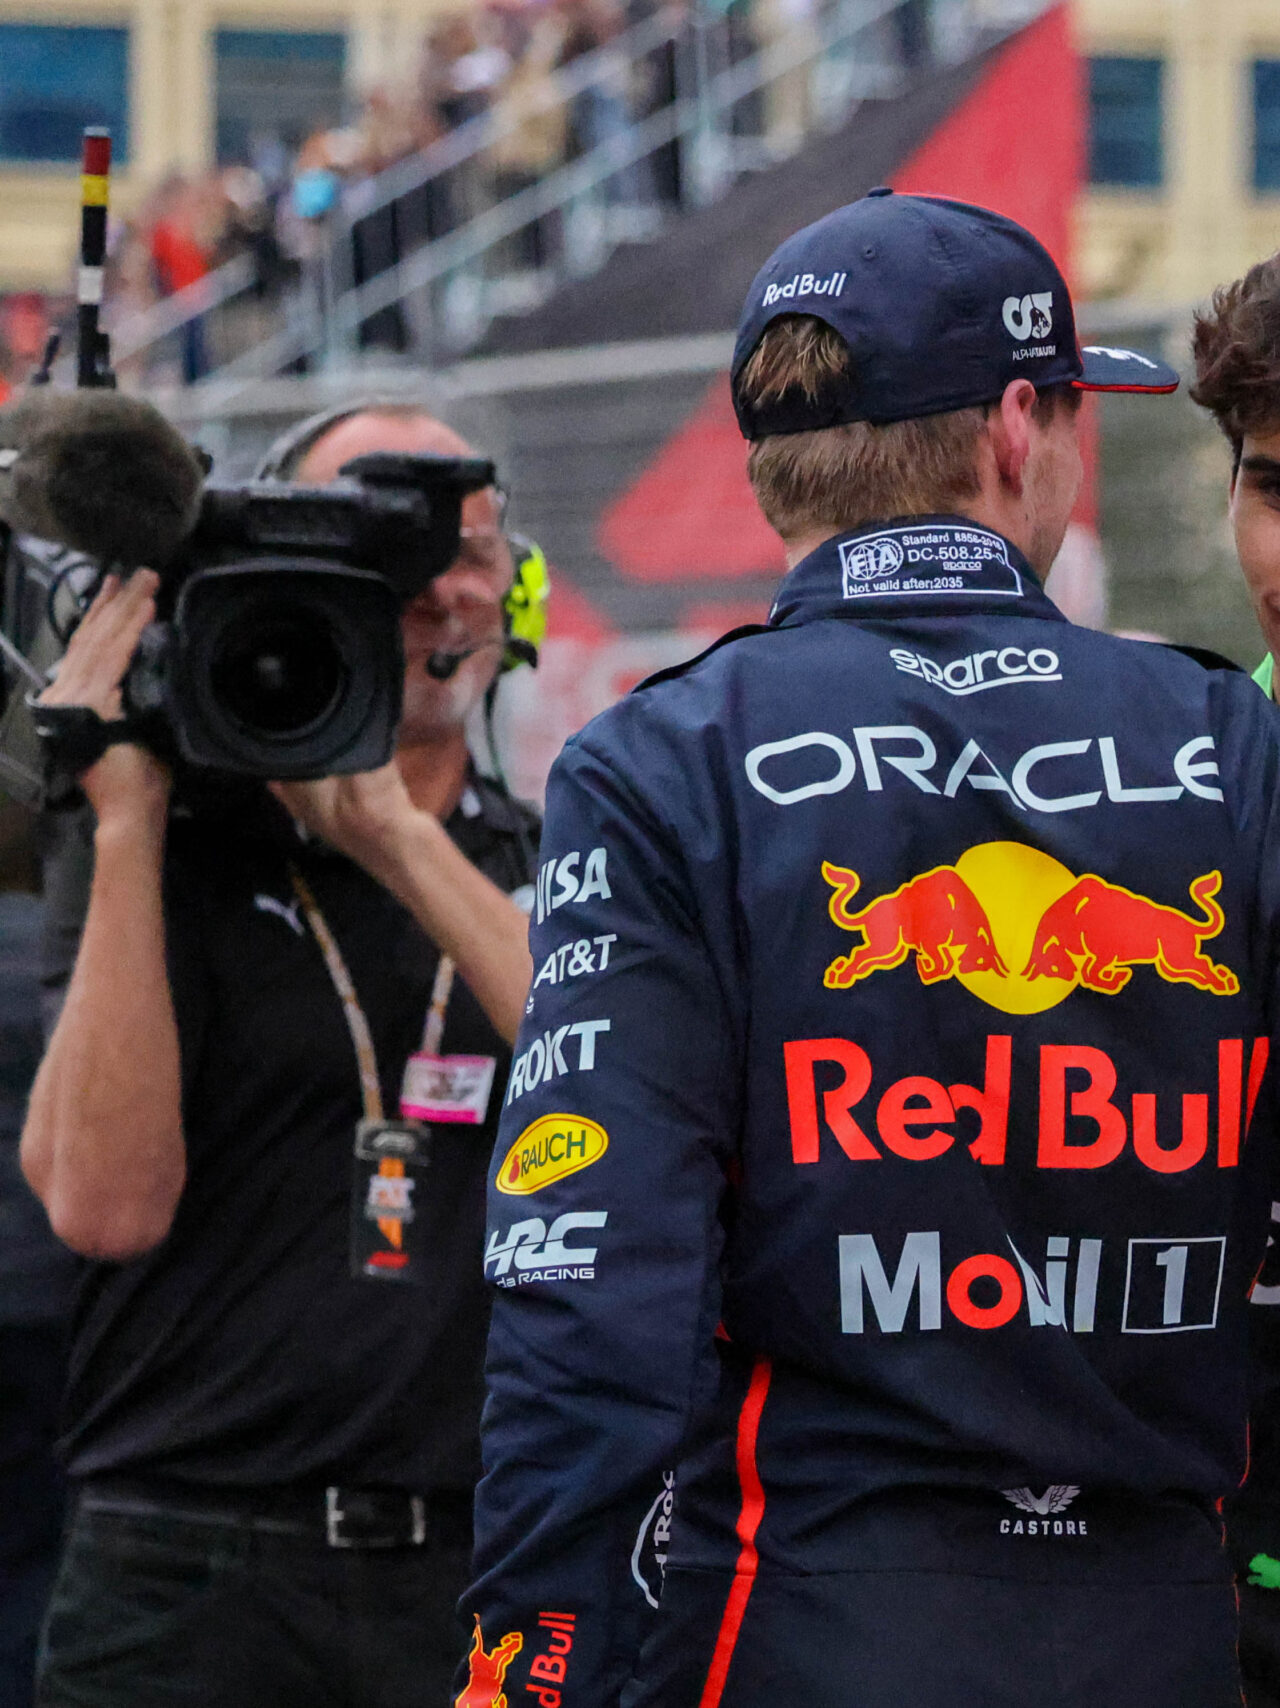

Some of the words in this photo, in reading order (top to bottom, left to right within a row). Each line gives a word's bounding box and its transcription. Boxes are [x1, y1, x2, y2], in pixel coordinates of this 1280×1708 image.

[1012, 345, 1056, 361] ALPHATAURI
[850, 543, 900, 578] FIA
[902, 532, 950, 546] Standard
[849, 584, 870, 595] Not
[872, 579, 900, 591] valid
[943, 561, 982, 571] sparco
[890, 647, 1060, 691] sparco
[744, 725, 1224, 813] ORACLE
[537, 847, 612, 925] VISA
[533, 933, 617, 989] AT&T
[507, 1019, 611, 1107] ROKT
[783, 1034, 1012, 1165] Red
[1036, 1035, 1269, 1174] Bull
[521, 1130, 586, 1177] RAUCH
[484, 1211, 608, 1277] HRC
[518, 1267, 595, 1286] RACING
[1156, 1246, 1189, 1325] 1
[1000, 1520, 1088, 1536] CASTORE
